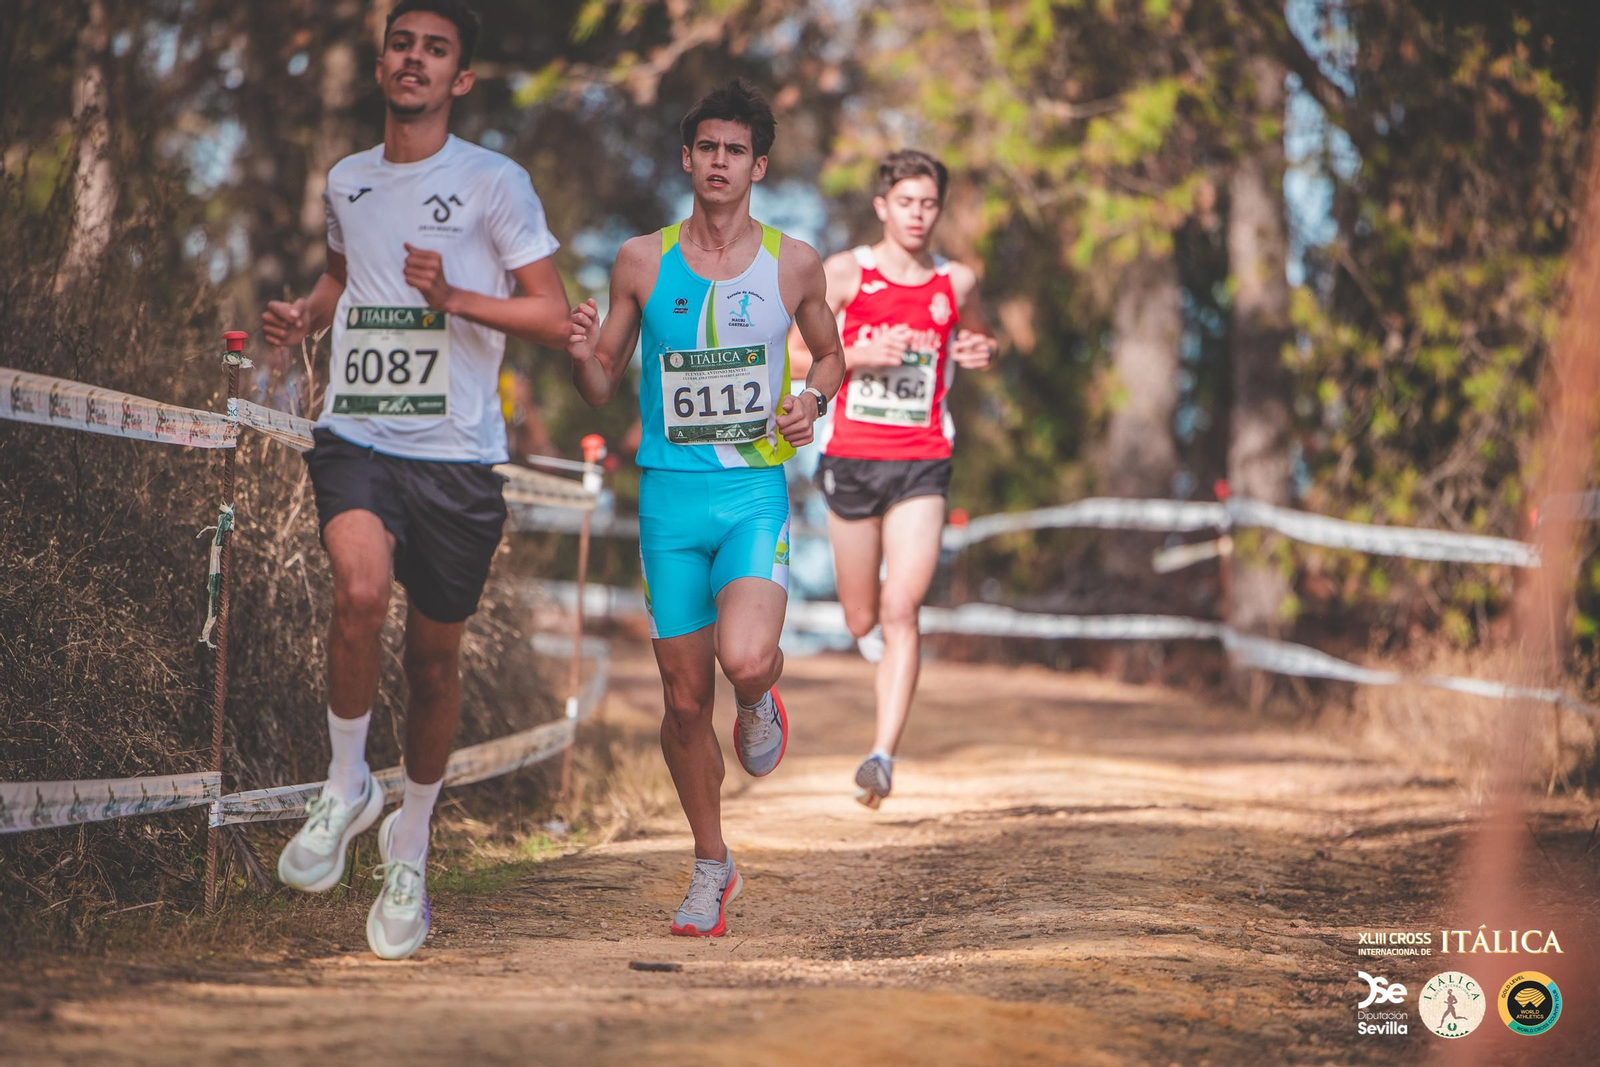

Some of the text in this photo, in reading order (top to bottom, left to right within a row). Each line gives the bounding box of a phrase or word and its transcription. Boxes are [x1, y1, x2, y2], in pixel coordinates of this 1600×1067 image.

[345, 348, 439, 385] 6087
[690, 351, 741, 365] ITÁLICA
[673, 380, 765, 418] 6112
